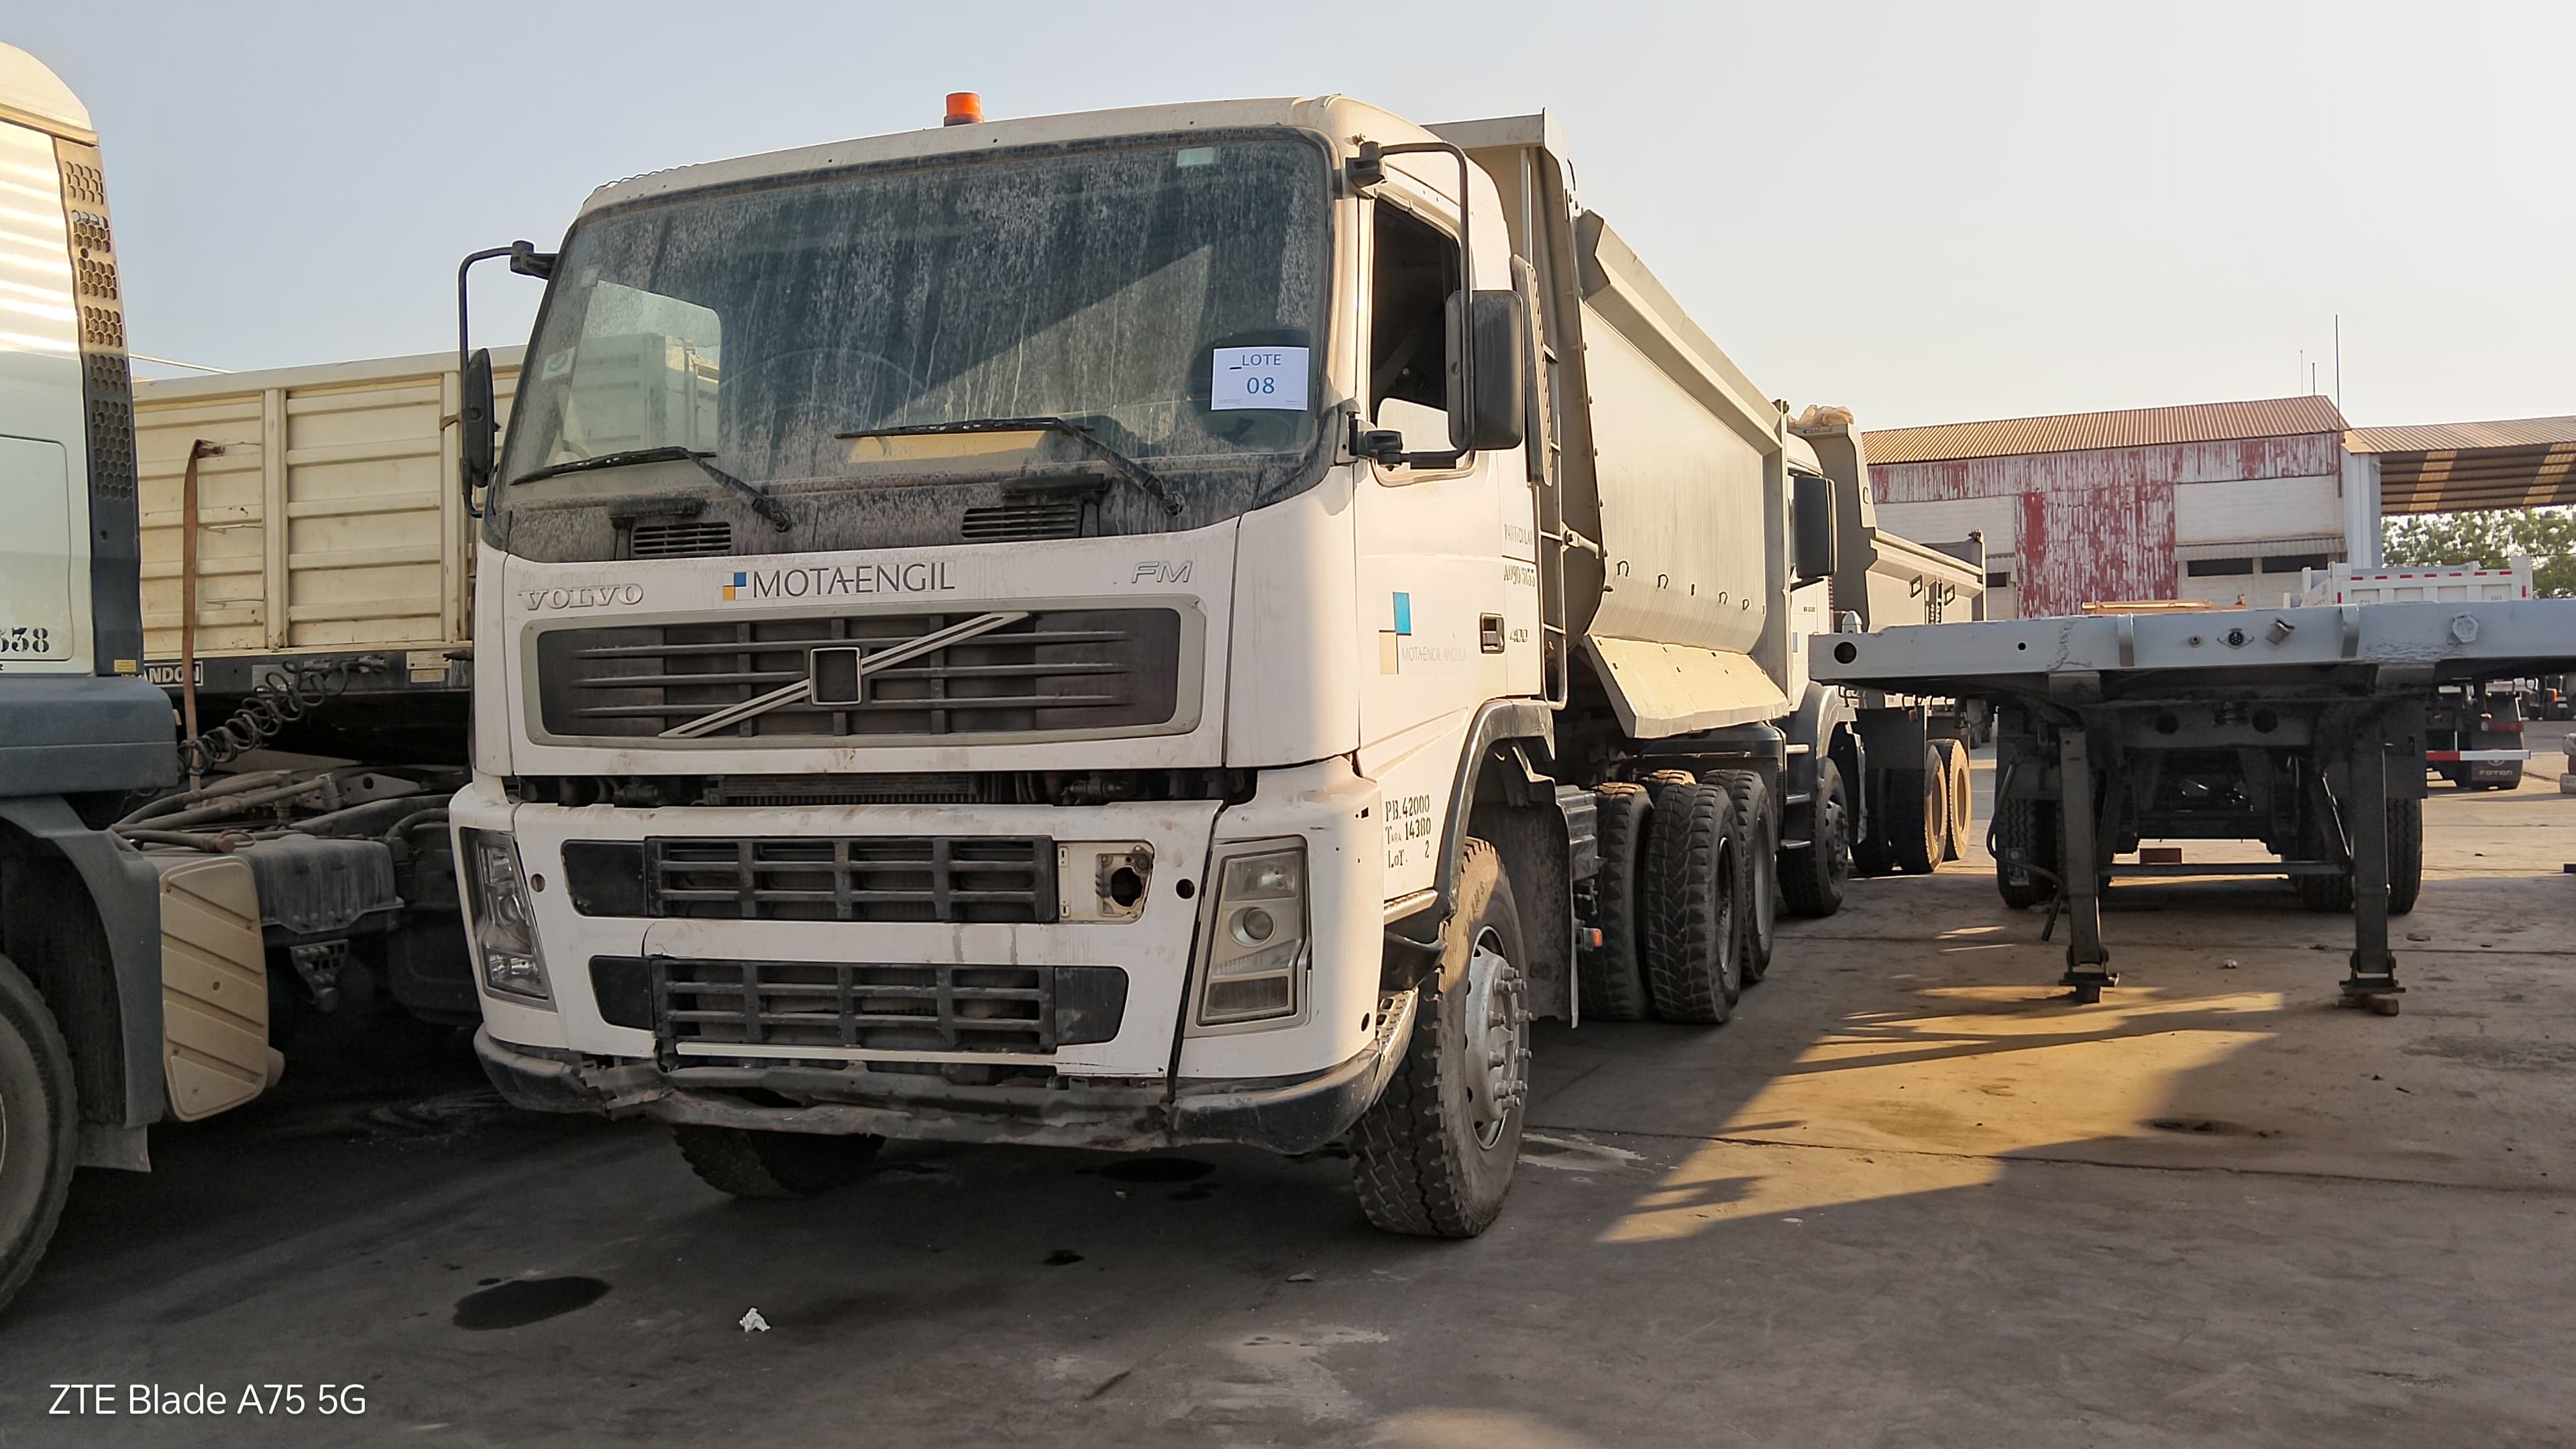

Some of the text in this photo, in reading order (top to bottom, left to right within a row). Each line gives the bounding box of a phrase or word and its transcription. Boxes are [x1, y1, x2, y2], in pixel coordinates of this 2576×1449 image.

[1242, 354, 1282, 366] LOTE
[1246, 377, 1275, 394] 08
[1131, 560, 1193, 584] FM
[517, 583, 644, 611] VOLVO
[1405, 816, 1432, 841] 14380
[1424, 839, 1430, 859] 2
